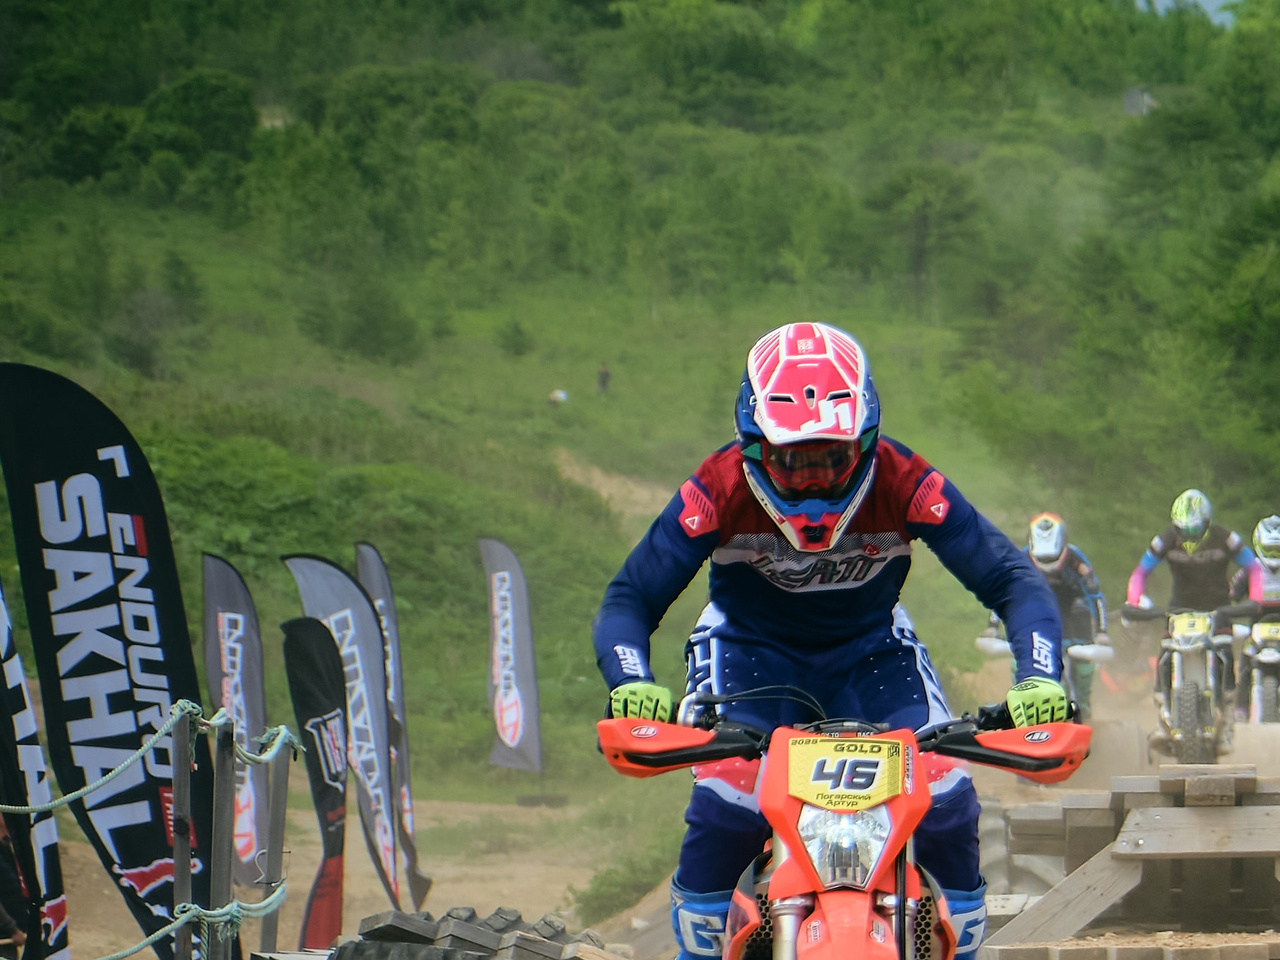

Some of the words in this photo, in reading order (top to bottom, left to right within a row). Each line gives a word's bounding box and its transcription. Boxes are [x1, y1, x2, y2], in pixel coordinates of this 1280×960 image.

[833, 743, 882, 754] GOLD
[811, 758, 880, 790] 46
[816, 793, 872, 801] Погарский
[825, 799, 858, 807] Артур
